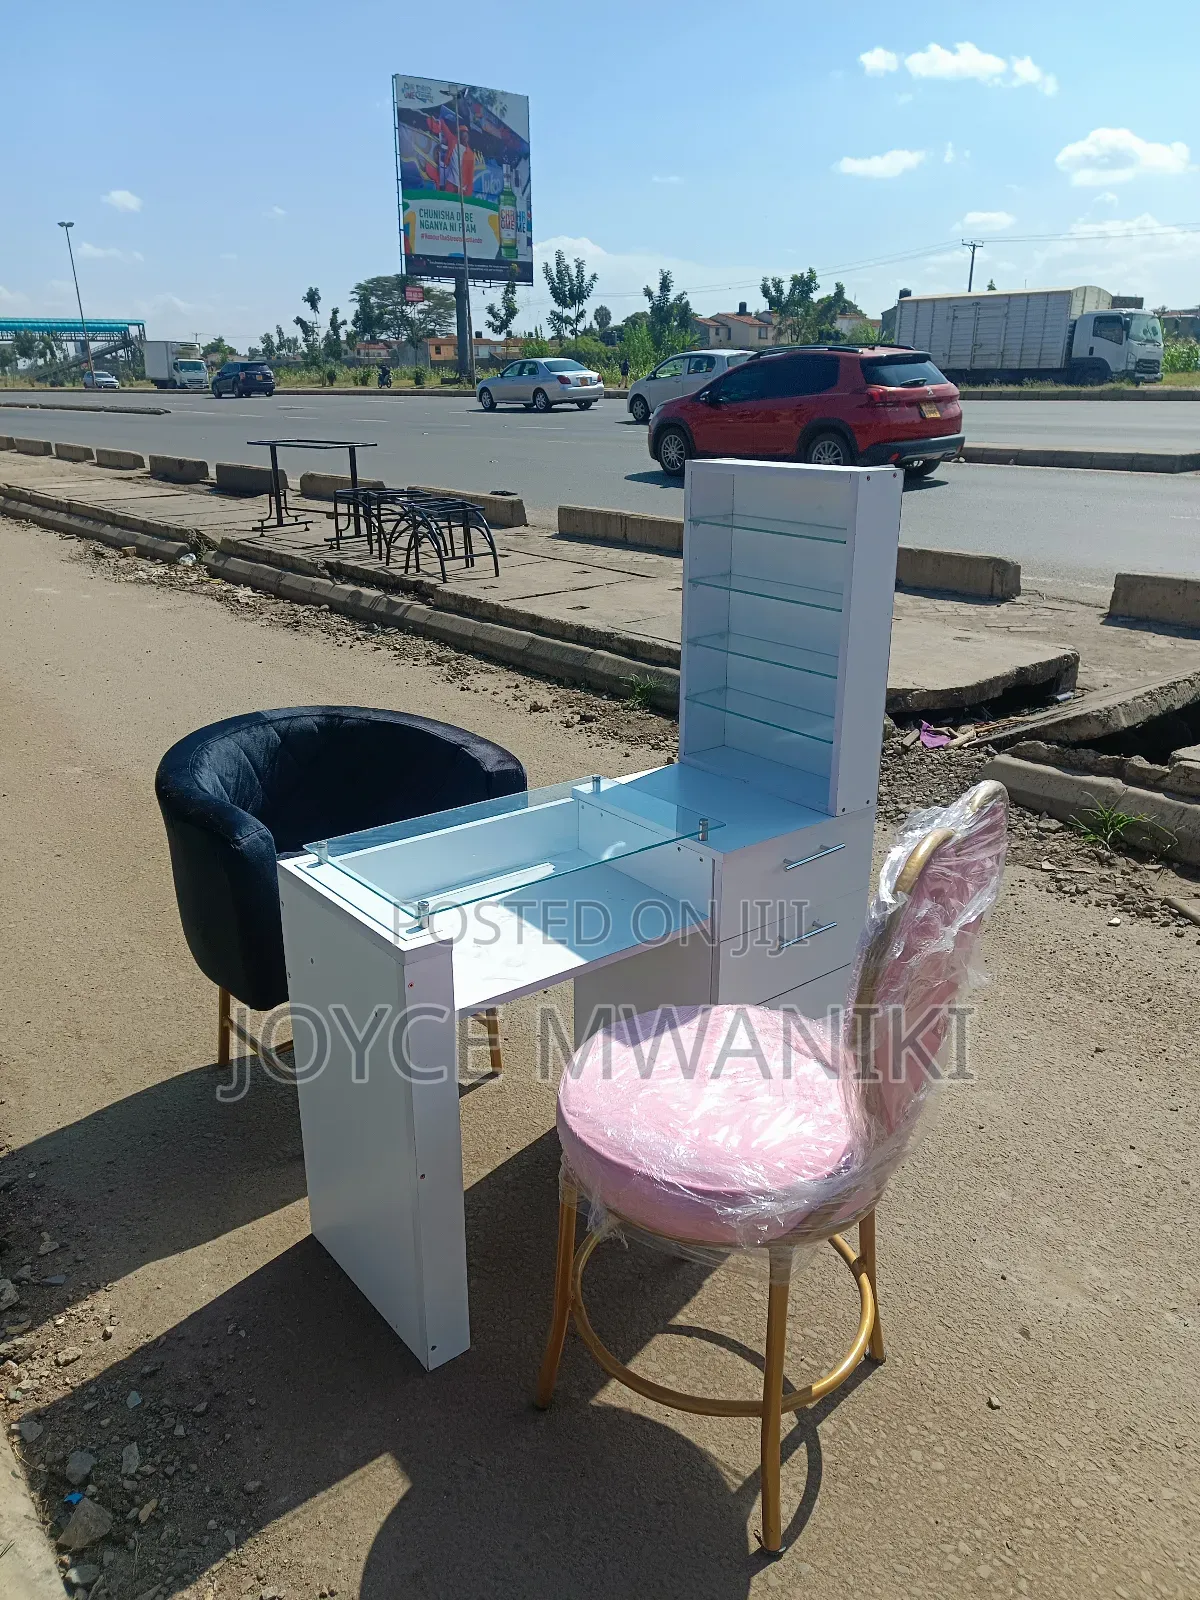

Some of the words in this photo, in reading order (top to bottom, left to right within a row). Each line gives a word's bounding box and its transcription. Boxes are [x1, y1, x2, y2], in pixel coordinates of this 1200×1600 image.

[419, 208, 455, 221] CHUNISHA
[456, 211, 474, 223] DBE
[419, 219, 448, 231] NGANYA
[449, 222, 457, 232] NI
[458, 222, 477, 234] FAM
